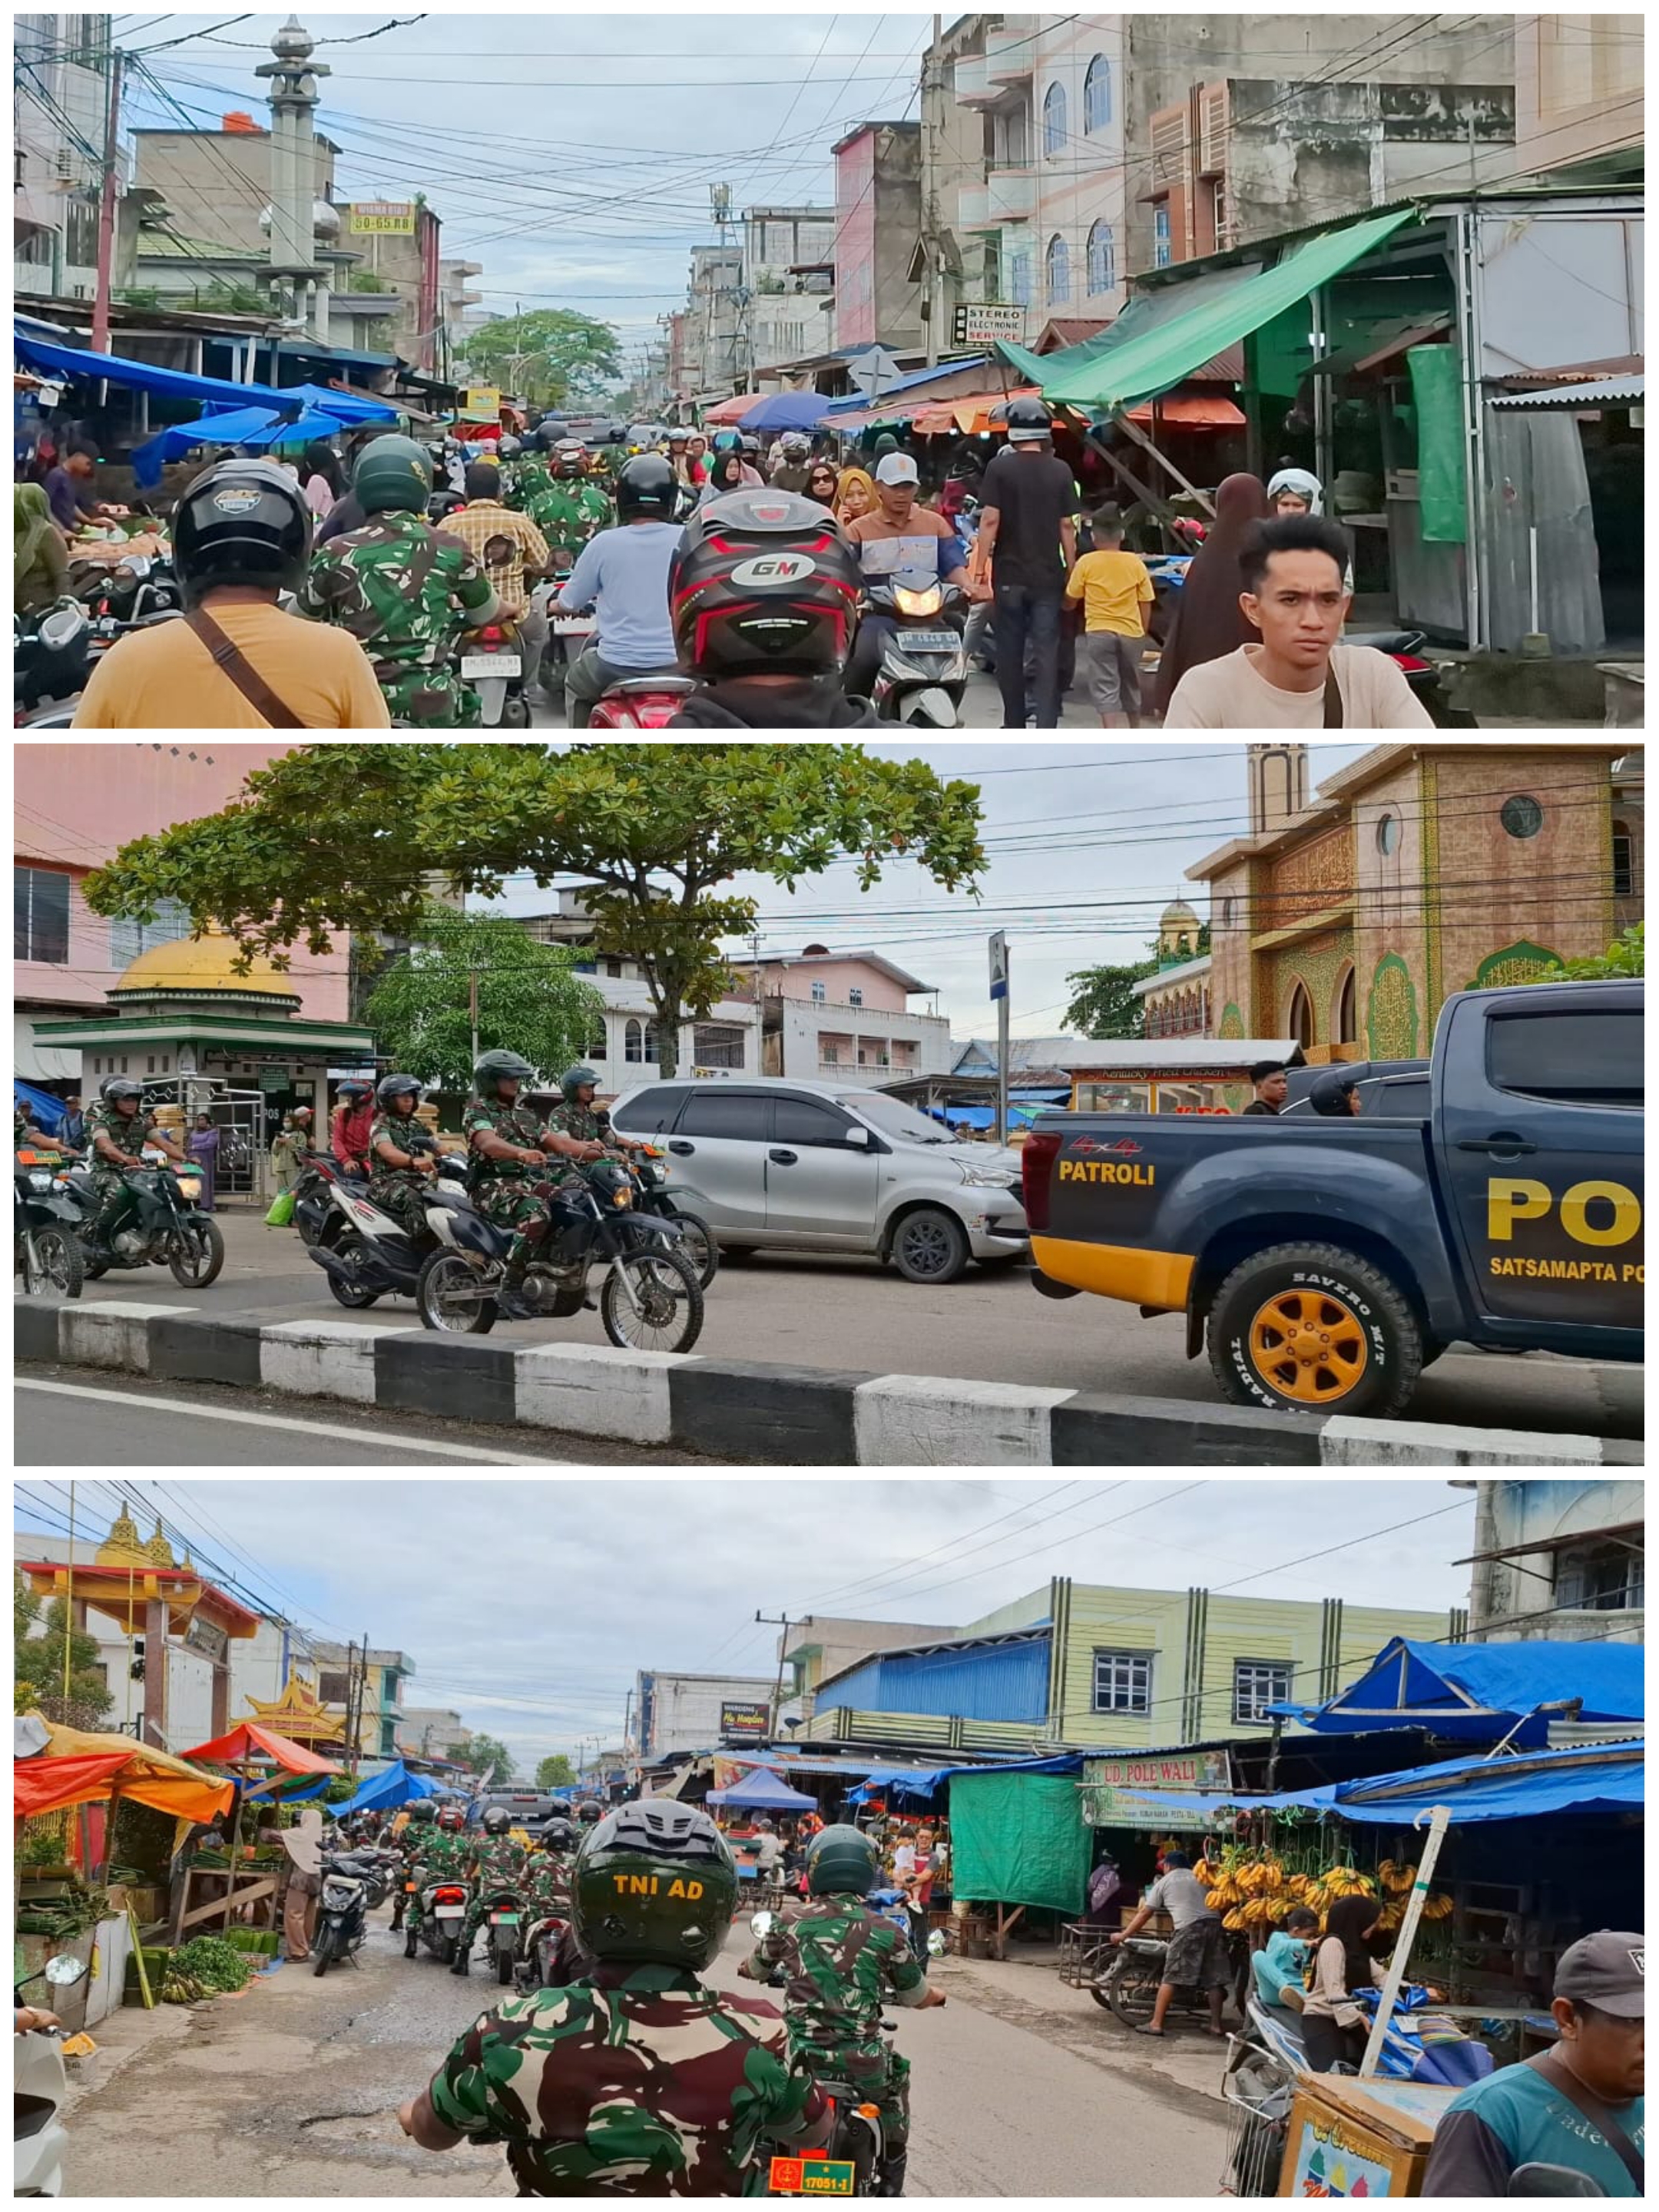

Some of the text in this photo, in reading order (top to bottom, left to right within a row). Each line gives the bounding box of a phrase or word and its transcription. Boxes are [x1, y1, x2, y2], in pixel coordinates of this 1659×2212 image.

[969, 309, 1020, 319] STEREO
[969, 320, 1018, 329] ELECTRONIC
[751, 561, 800, 576] GM
[1060, 1161, 1154, 1185] PATROLI
[1490, 1257, 1618, 1282] SATSAMAPTA
[1292, 1272, 1371, 1316] SAVERO
[1369, 1324, 1386, 1366] M/T
[1230, 1336, 1277, 1408] RADIAL
[1104, 1760, 1197, 1783] UD. POLE WALI
[613, 1875, 704, 1899] TNI AD
